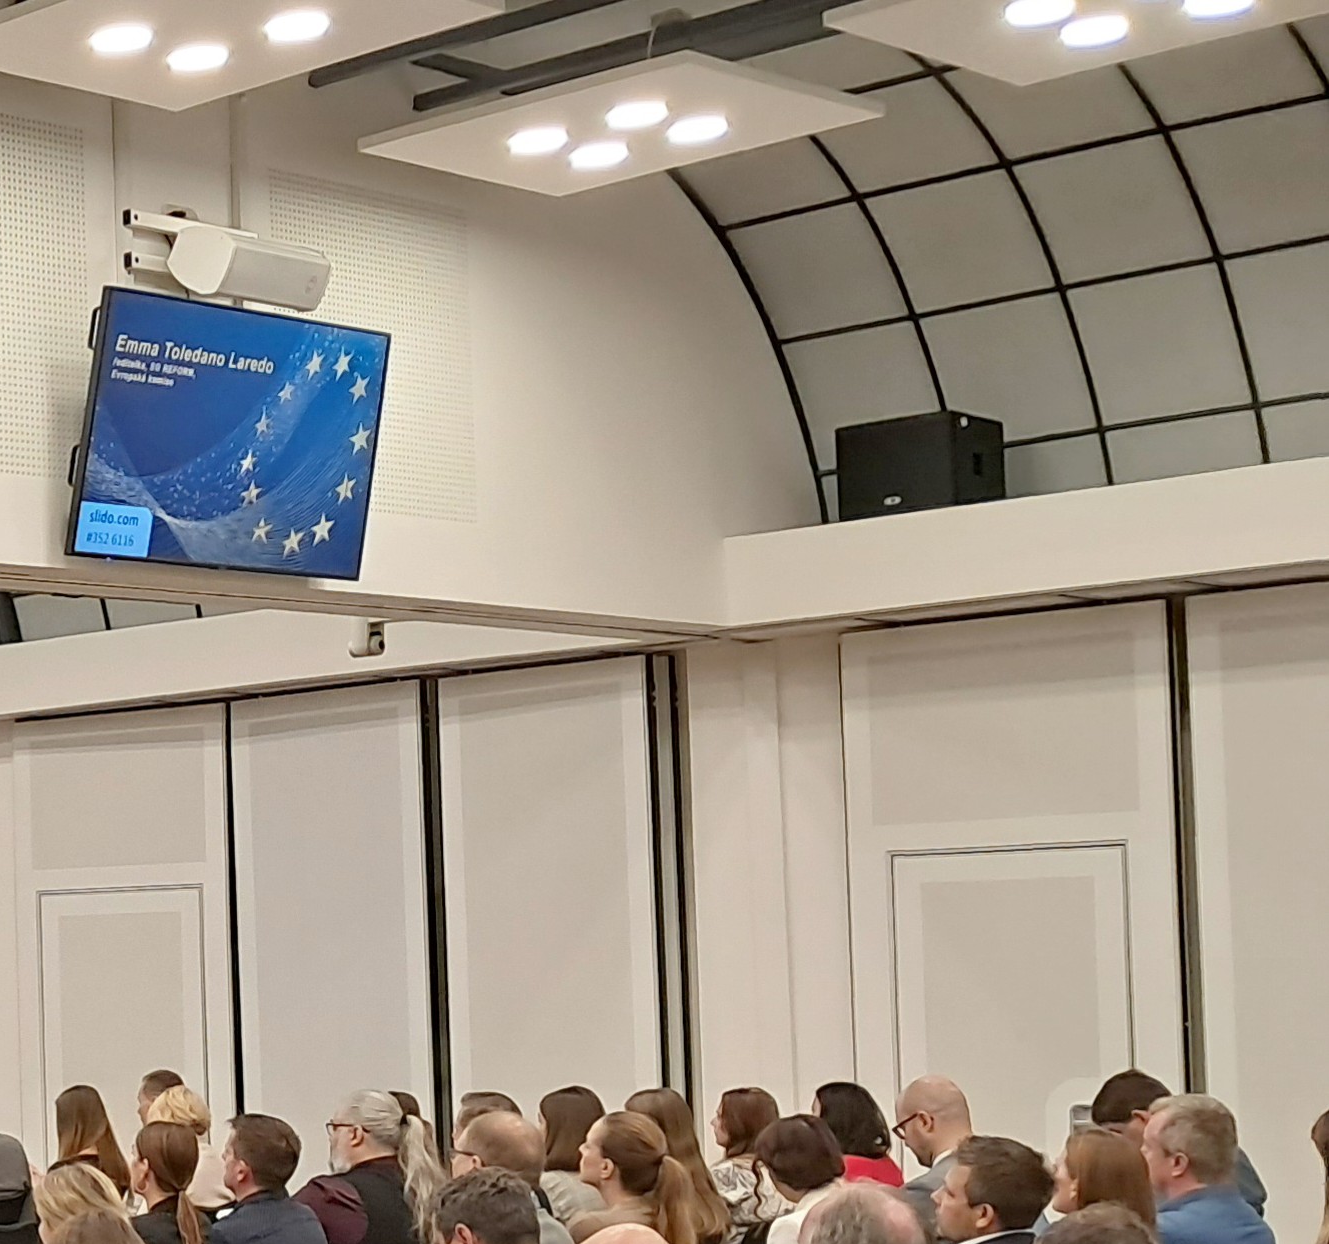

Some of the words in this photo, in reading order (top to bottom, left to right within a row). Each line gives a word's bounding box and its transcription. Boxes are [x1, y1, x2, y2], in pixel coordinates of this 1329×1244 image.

[115, 334, 159, 356] Emma
[164, 341, 225, 367] Toledano
[228, 352, 274, 374] Laredo
[89, 509, 139, 526] slido.com
[86, 532, 109, 545] #352
[111, 533, 134, 547] 6116
